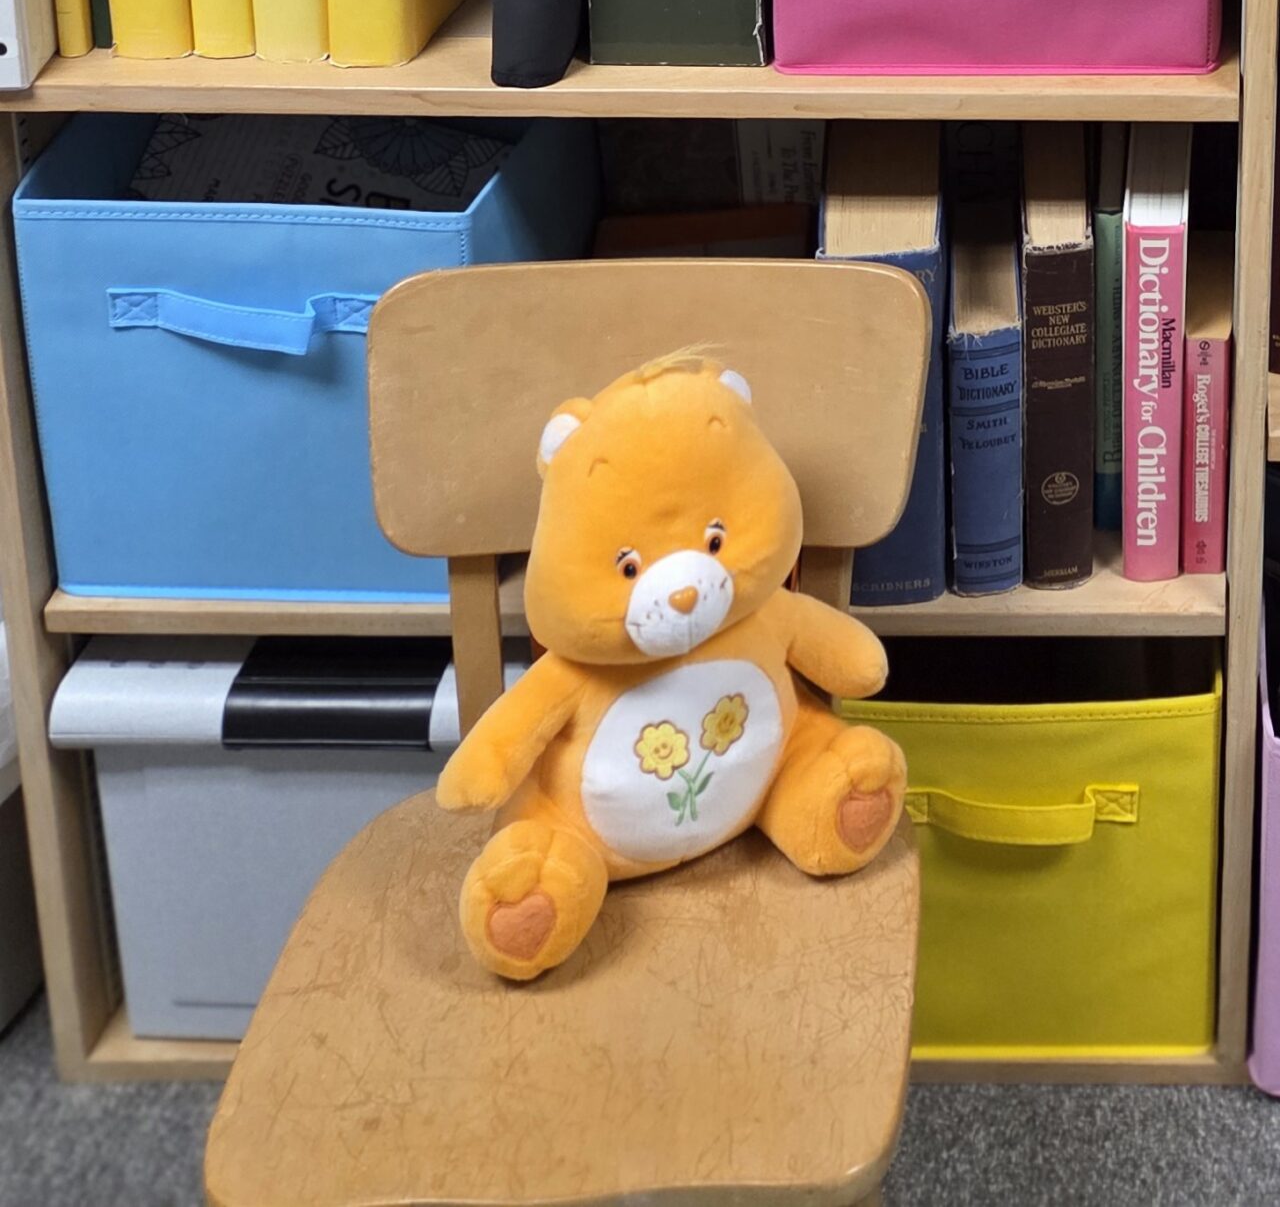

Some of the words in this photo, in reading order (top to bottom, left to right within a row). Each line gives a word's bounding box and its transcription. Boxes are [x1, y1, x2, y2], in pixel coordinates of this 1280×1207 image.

[1032, 301, 1087, 316] WEBSTER'S
[1049, 314, 1071, 325] NEW
[1133, 239, 1169, 397] Dictionary
[1031, 323, 1087, 339] COLLEGIATE
[1031, 334, 1088, 350] DICTIONARY
[1160, 318, 1176, 388] Macmillan
[961, 363, 1009, 381] BIBLE
[956, 380, 1018, 401] DICTIONARY
[1191, 375, 1211, 422] Roget's
[1140, 402, 1154, 423] for
[966, 416, 1008, 430] SMITH
[1194, 423, 1210, 465] COLLEGE
[1136, 425, 1166, 547] Children
[963, 555, 1014, 570] WINSTON
[1043, 565, 1079, 577] MERRIAM
[852, 578, 931, 592] SCRIBNERS
